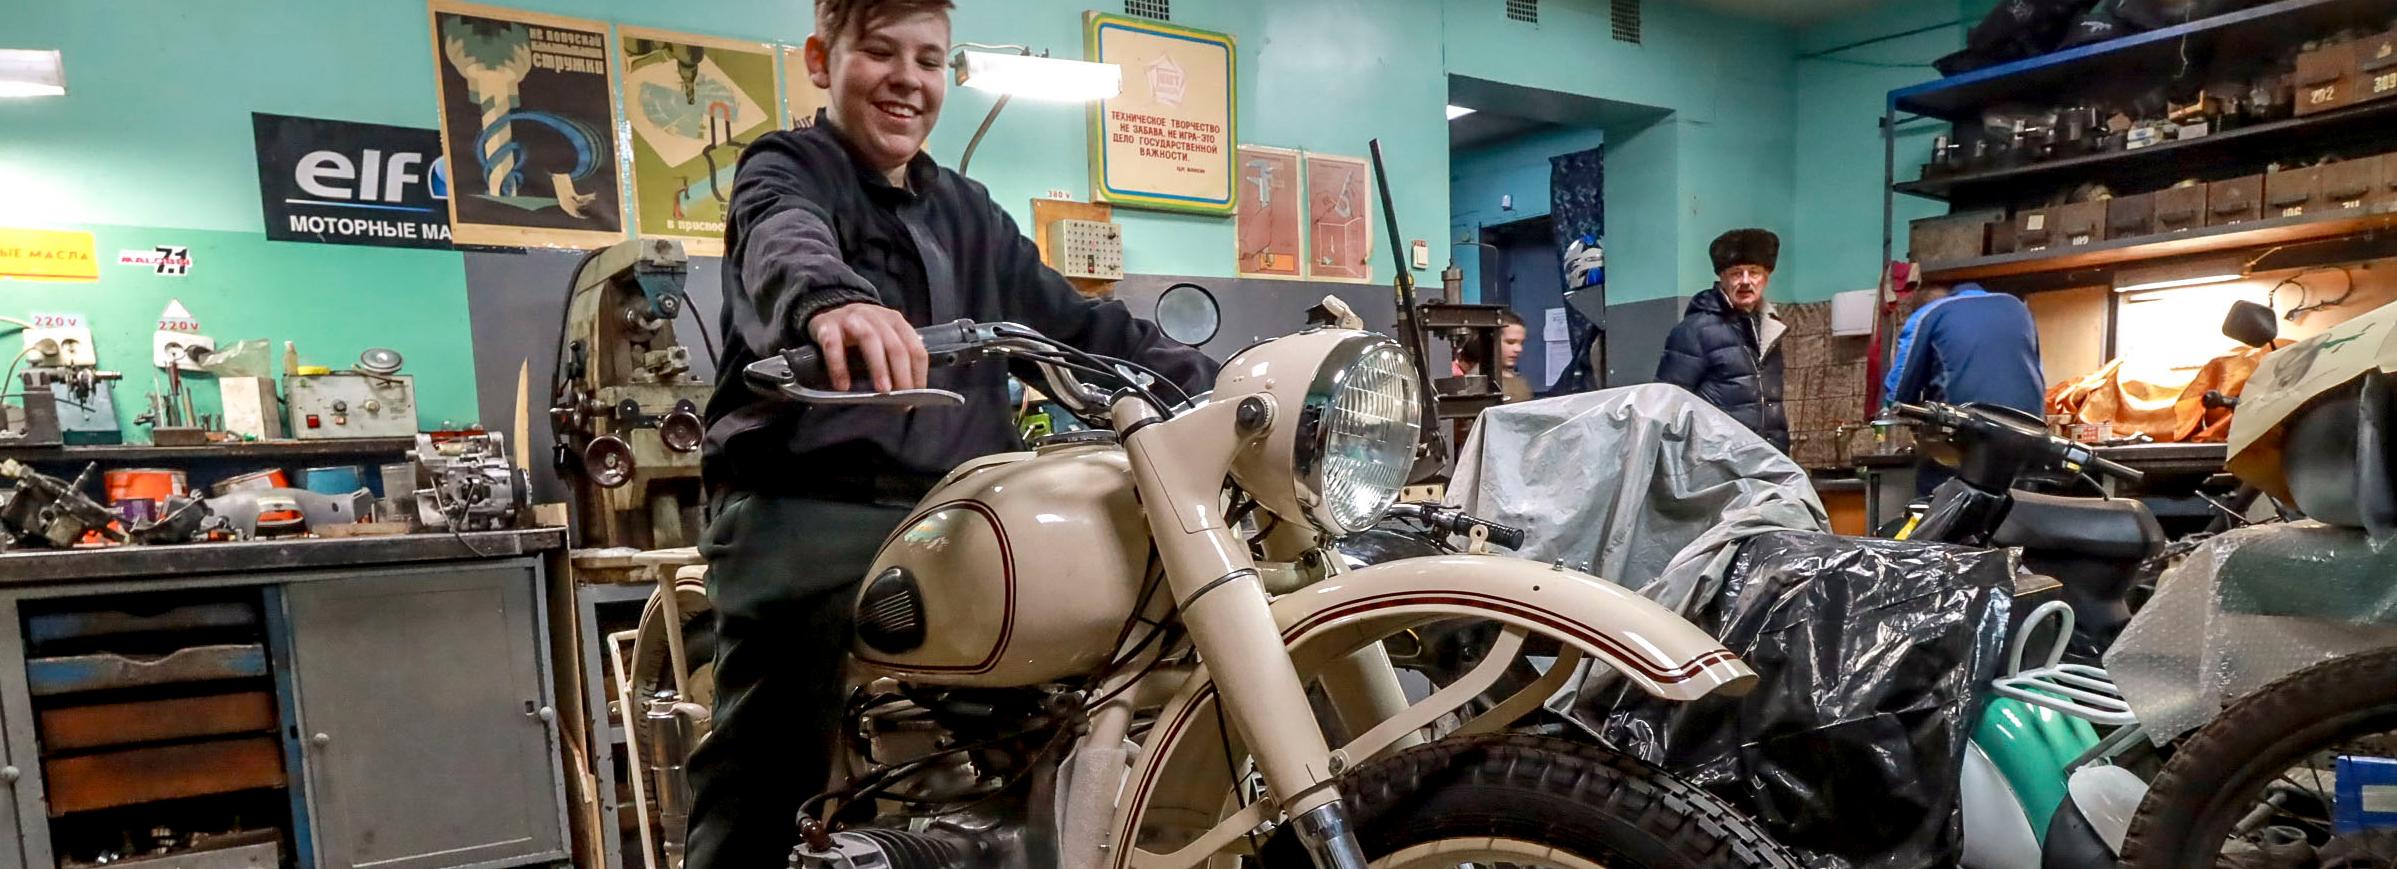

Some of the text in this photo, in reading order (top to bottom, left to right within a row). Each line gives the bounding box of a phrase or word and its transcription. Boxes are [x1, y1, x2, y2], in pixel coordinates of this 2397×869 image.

[1111, 110, 1220, 133] ТЕХНИЧЕСКОЕ ТВОРЧЕСТВО
[1120, 123, 1130, 133] НЕ
[1167, 129, 1177, 138] НЕ
[1113, 133, 1218, 154] ДЕЛО ГОСУДАРСТВЕННОЙ
[1139, 147, 1190, 162] ВАЖНОСТИ.
[295, 149, 423, 202] elf
[289, 215, 417, 239] МОТОРНЫЕ
[29, 249, 89, 260] МАСЛА
[155, 246, 188, 275] 7.1
[34, 316, 64, 327] 220
[159, 321, 188, 331] 220
